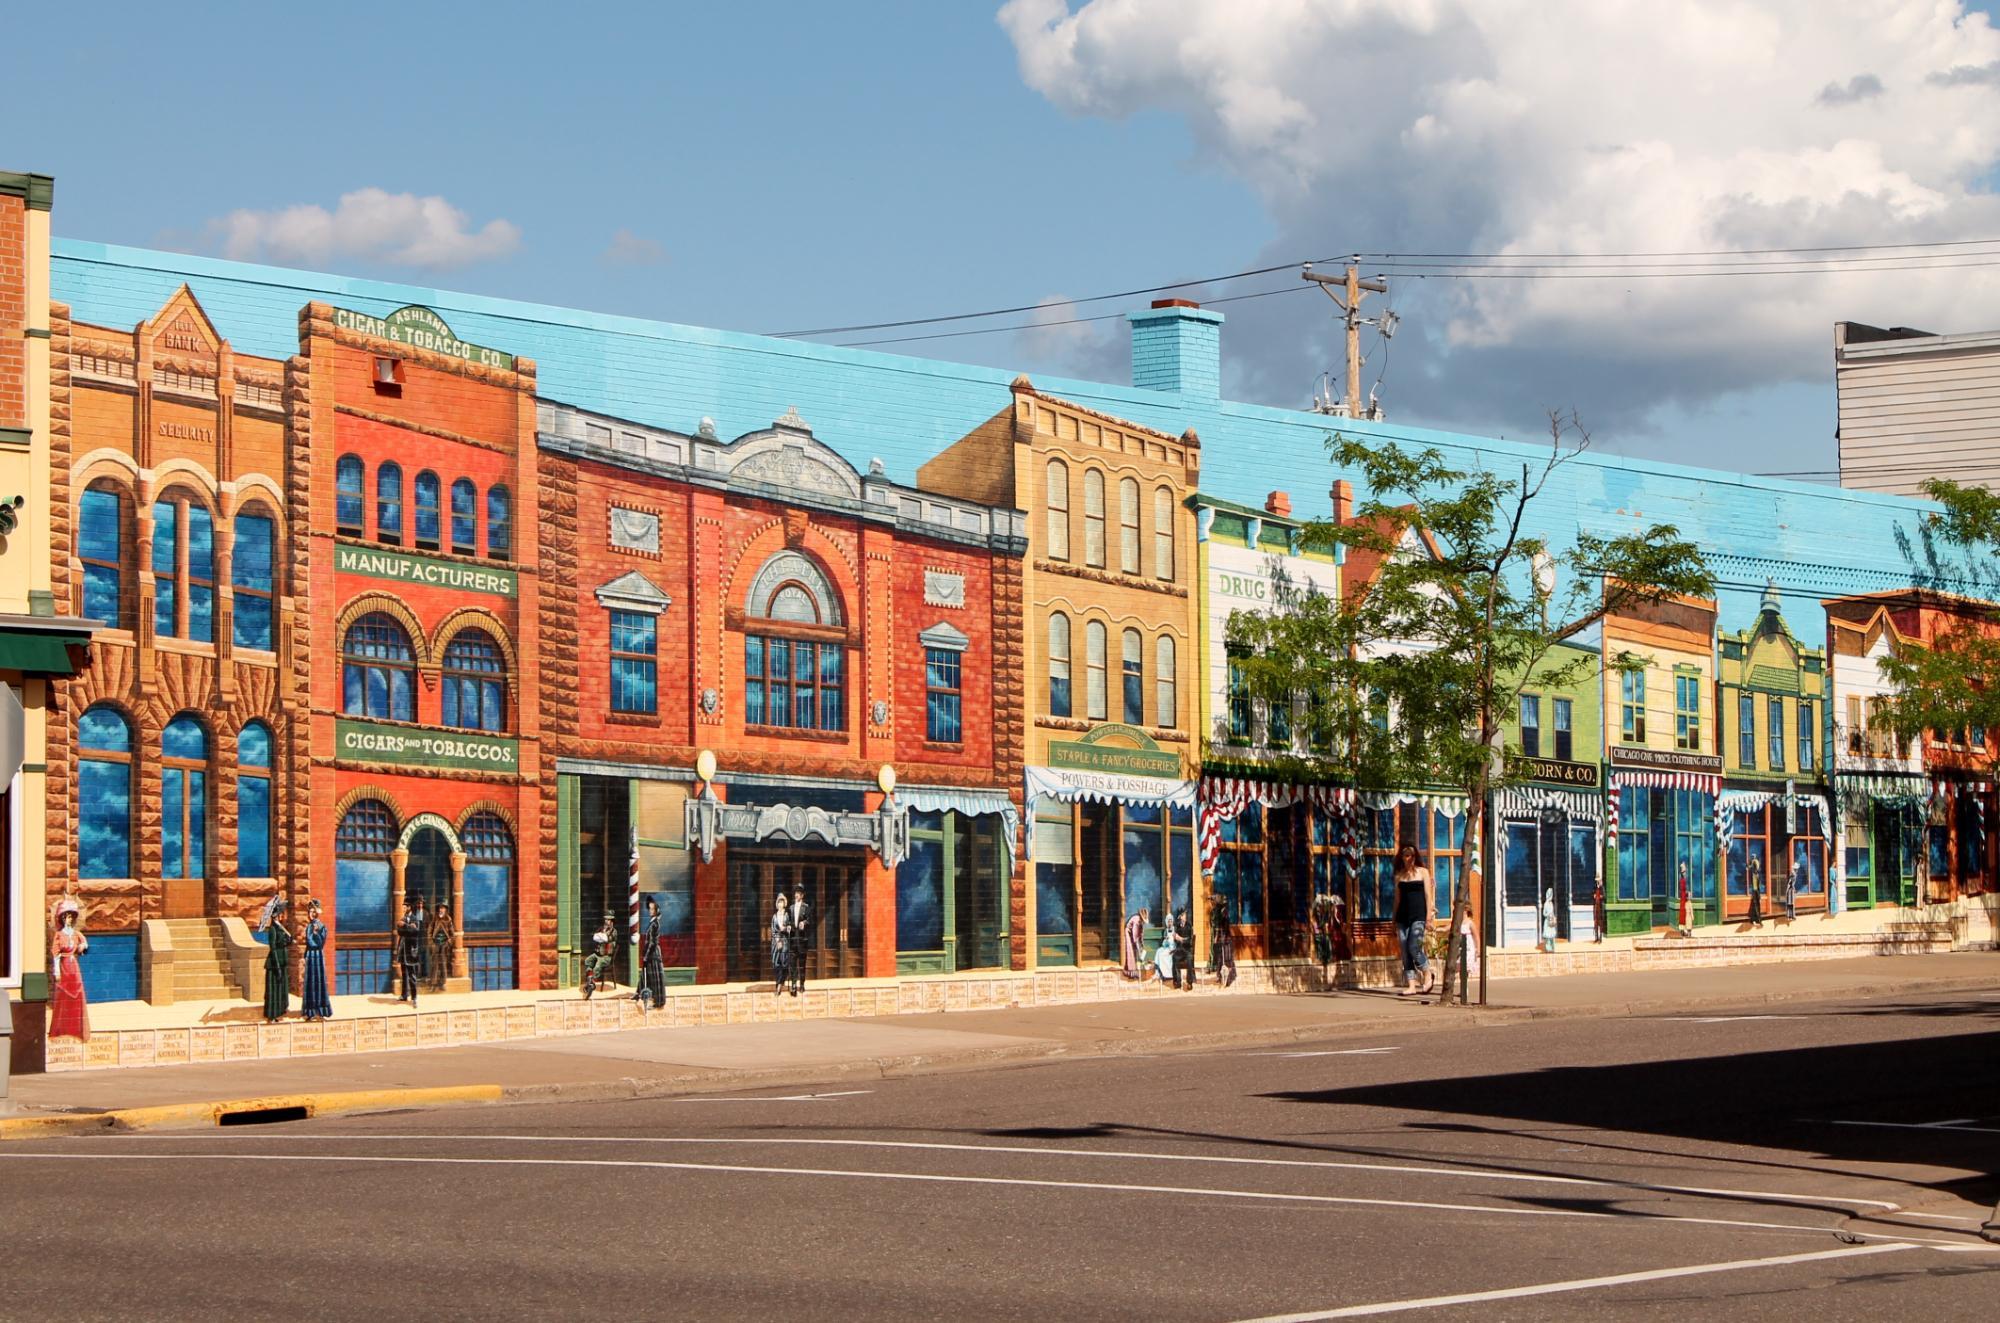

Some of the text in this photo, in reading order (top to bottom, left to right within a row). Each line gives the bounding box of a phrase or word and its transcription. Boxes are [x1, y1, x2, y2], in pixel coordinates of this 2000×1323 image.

[395, 310, 448, 337] ASHLAND
[165, 332, 200, 353] BANK
[337, 309, 503, 368] CIGAR & TOBACCO CO.
[159, 422, 214, 443] SECURITY
[341, 551, 511, 594] MANUFACTURERS
[780, 588, 807, 606] ROYAL
[1219, 574, 1266, 600] DRUG
[345, 732, 515, 763] CIGARS AND TOBACCOS.
[1613, 748, 1641, 761] CHICAGO
[1671, 755, 1701, 766] CLOTHING
[1701, 757, 1721, 767] HOUSE
[1056, 749, 1176, 772] STAPLE & FANCY GROCERIES
[1061, 772, 1169, 796] POWERS & FOSSHAGE
[1564, 767, 1574, 780] &
[1576, 767, 1596, 782] CO.
